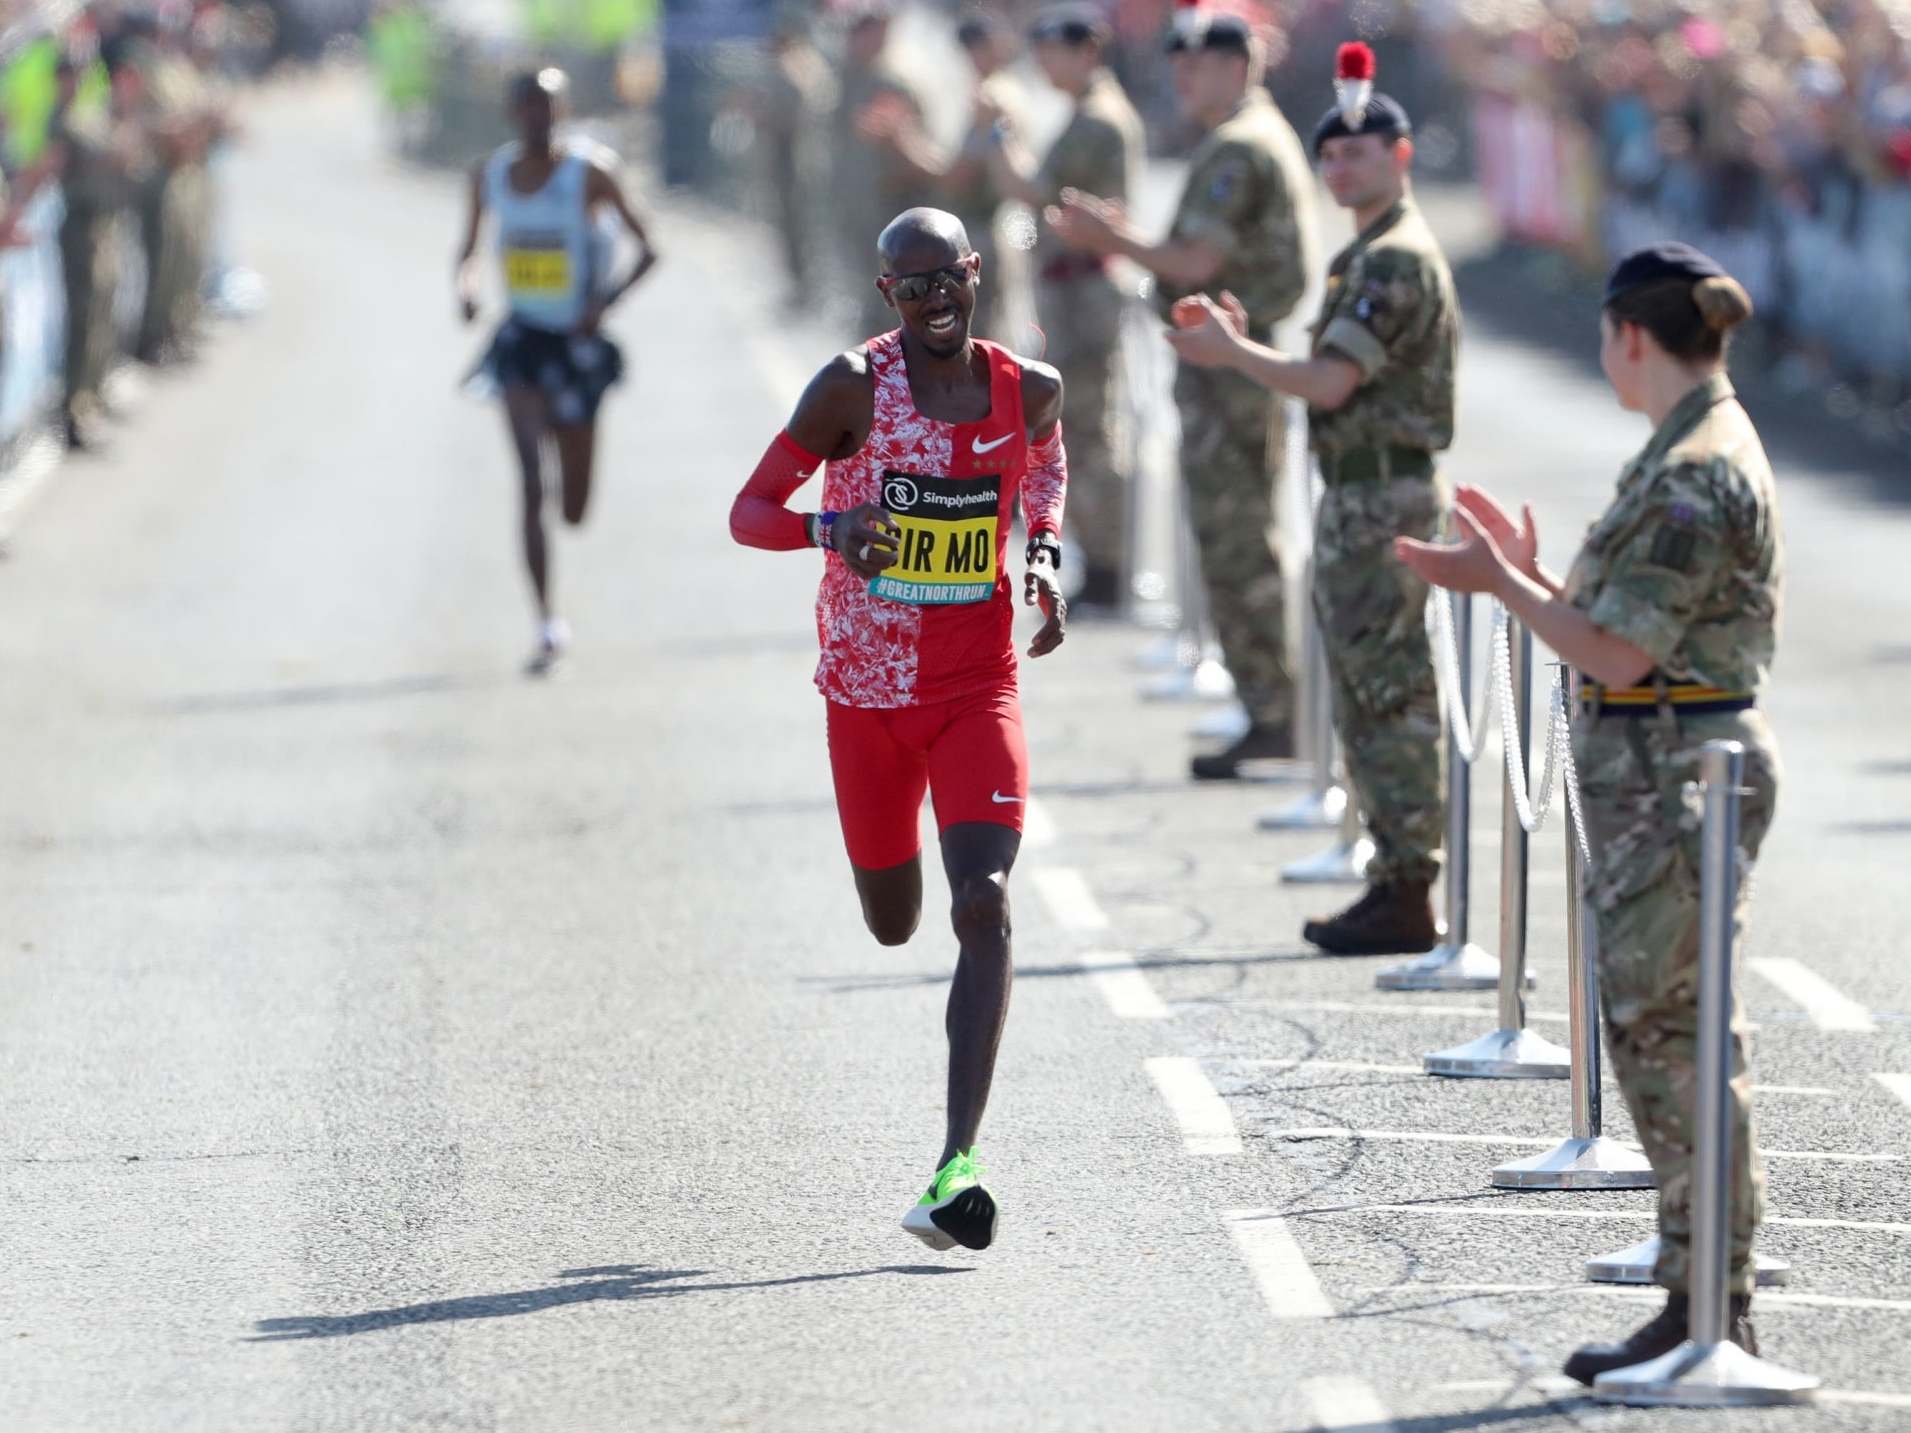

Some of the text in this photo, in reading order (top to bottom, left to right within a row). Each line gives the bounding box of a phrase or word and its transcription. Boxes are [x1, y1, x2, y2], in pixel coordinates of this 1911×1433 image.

[923, 490, 997, 508] Simplyhealth
[945, 529, 989, 573] MO
[877, 579, 986, 600] #GREATNORTHRUN
